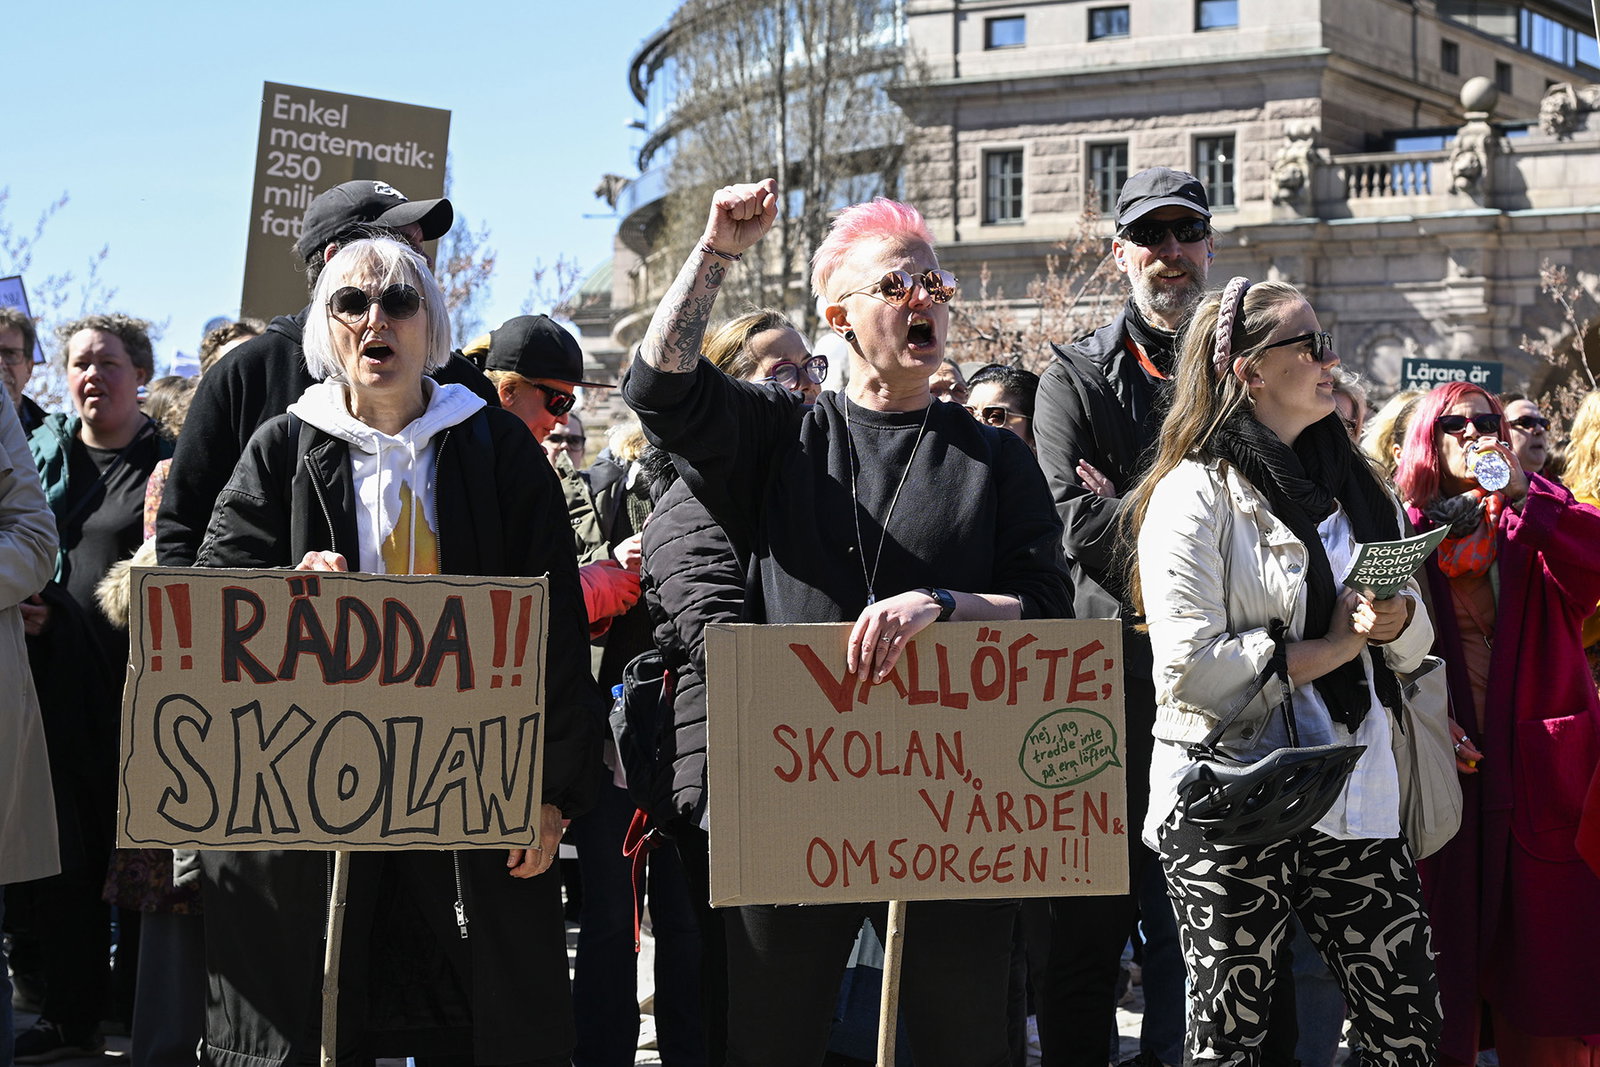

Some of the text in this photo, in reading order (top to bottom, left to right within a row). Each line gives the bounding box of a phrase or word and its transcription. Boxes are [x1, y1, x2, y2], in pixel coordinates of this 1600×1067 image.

[273, 93, 348, 128] Enkel
[270, 127, 435, 170] matematik:
[266, 151, 321, 181] 250
[264, 183, 314, 211] milj
[260, 208, 302, 239] fat
[1407, 362, 1491, 383] Lärare är
[1362, 551, 1425, 566] skolan,
[1366, 541, 1427, 557] Rädda
[1357, 563, 1413, 575] stötta
[222, 575, 475, 692] RÄDDA
[1030, 721, 1078, 745] nej, jag
[1033, 728, 1102, 763] trodde inte
[153, 694, 540, 837] SKOLAN
[773, 724, 972, 783] SKOLAN,
[1042, 763, 1057, 783] på
[1079, 745, 1112, 767] löften
